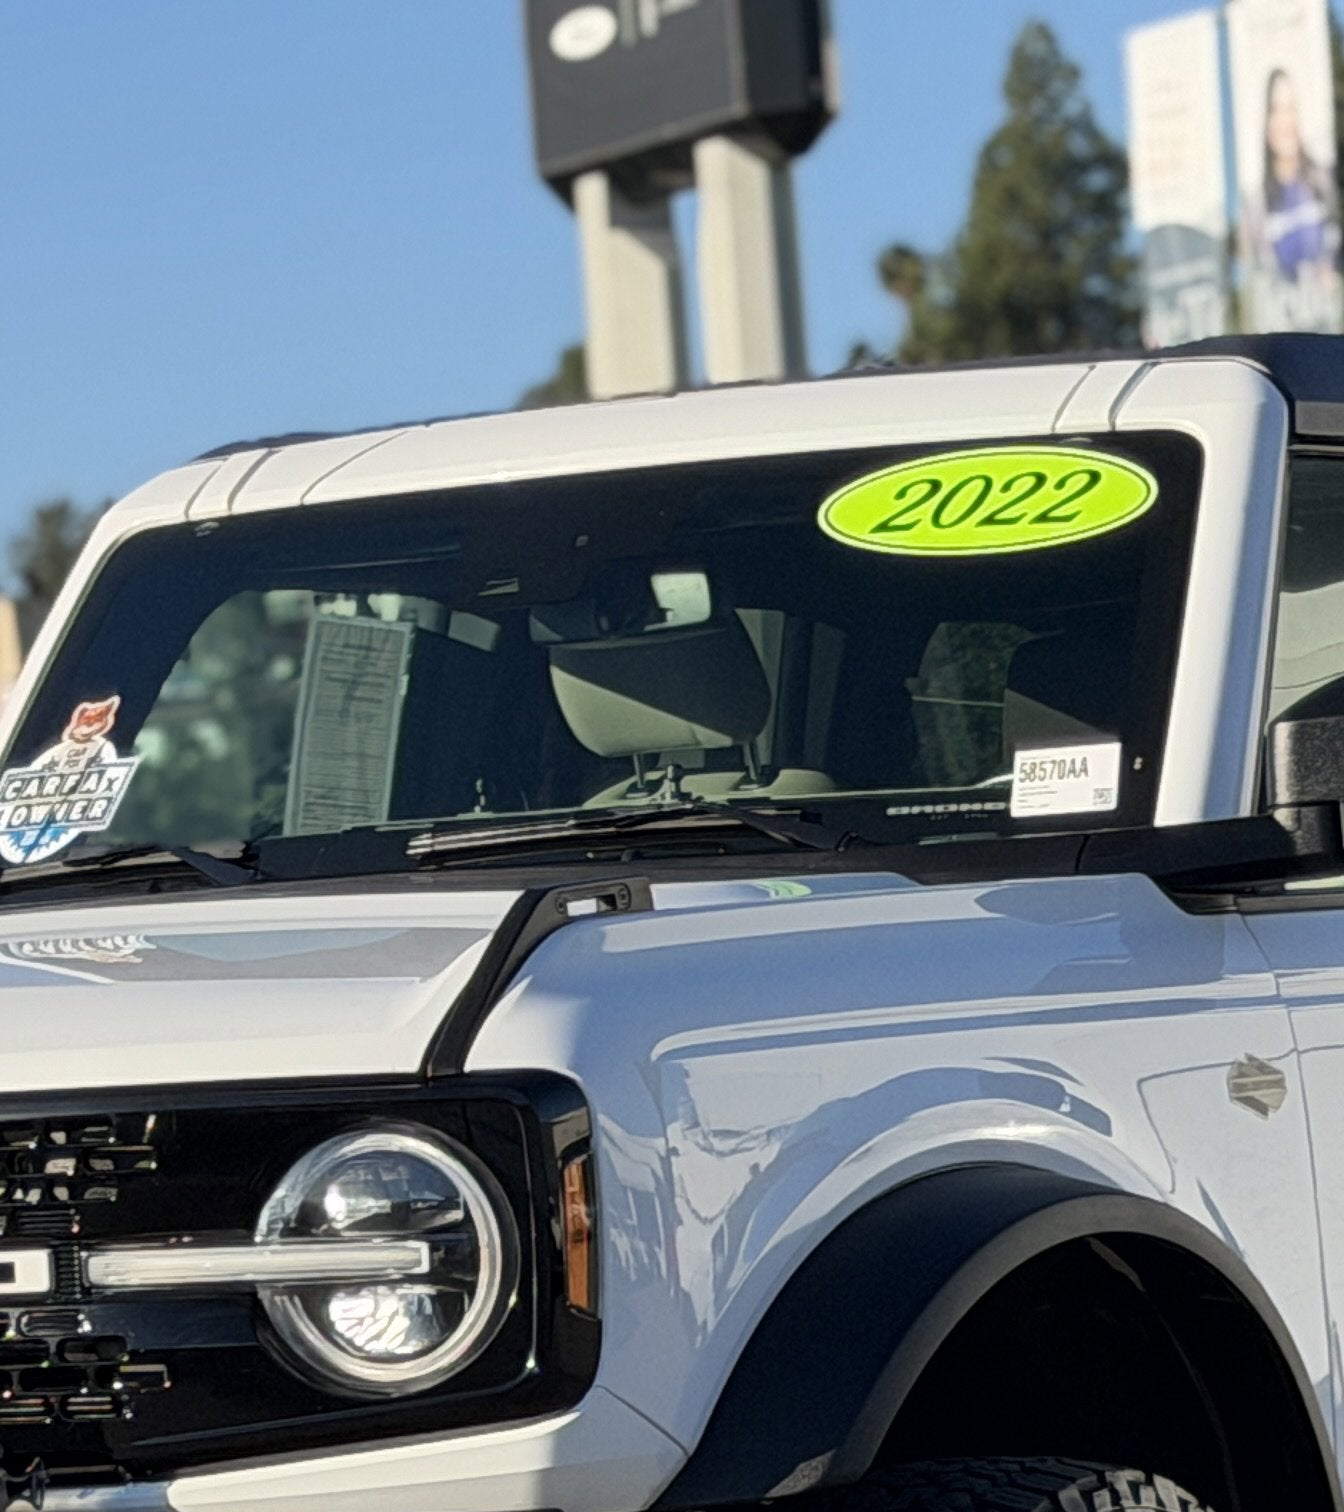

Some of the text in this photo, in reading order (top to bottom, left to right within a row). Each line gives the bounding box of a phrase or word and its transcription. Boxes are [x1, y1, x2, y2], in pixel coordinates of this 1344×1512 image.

[867, 468, 1103, 535] 2022
[1018, 756, 1089, 783] 58570AA
[5, 772, 120, 801] CARFAX
